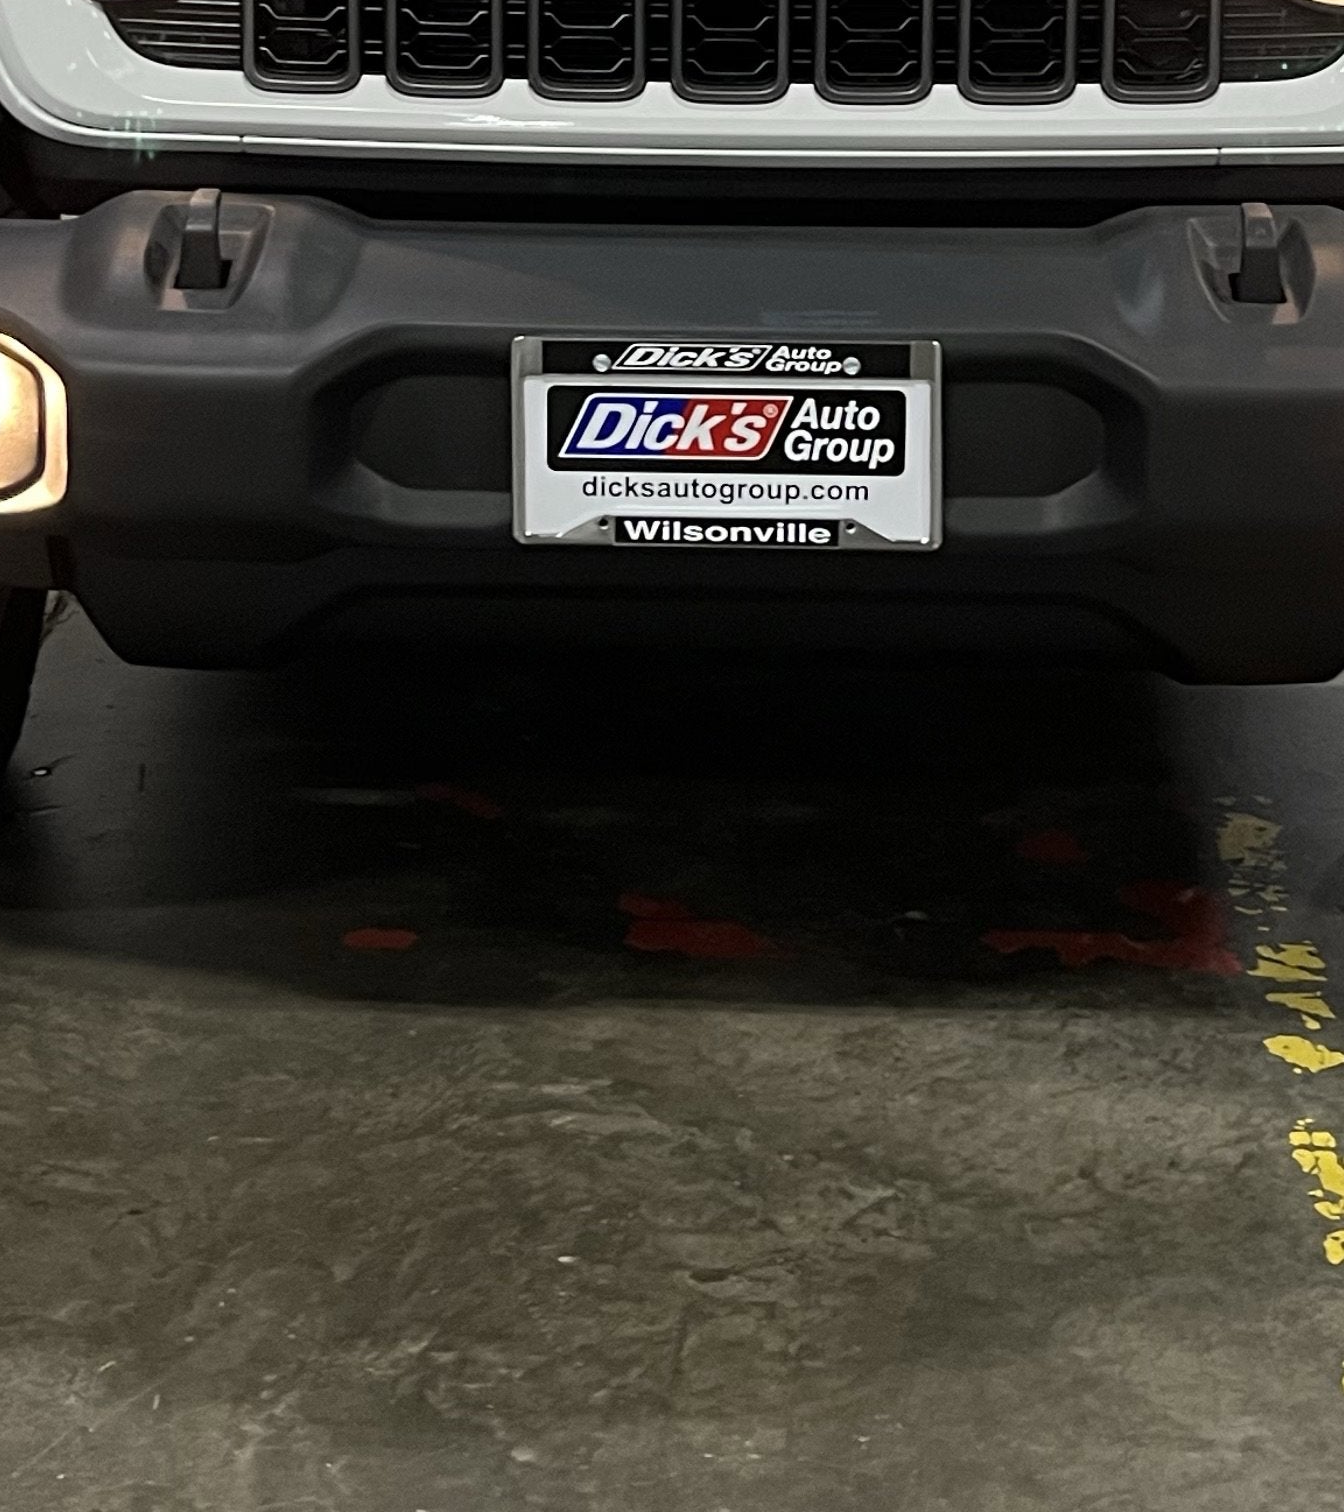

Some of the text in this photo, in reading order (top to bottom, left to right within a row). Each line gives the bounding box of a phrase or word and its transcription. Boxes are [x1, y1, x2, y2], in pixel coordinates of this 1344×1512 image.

[771, 345, 832, 360] Auto
[765, 358, 843, 375] Group
[790, 398, 881, 431] Auto
[783, 430, 896, 470] Group
[582, 476, 870, 505] dicksautogroup.com
[622, 519, 832, 545] Wilsonville
